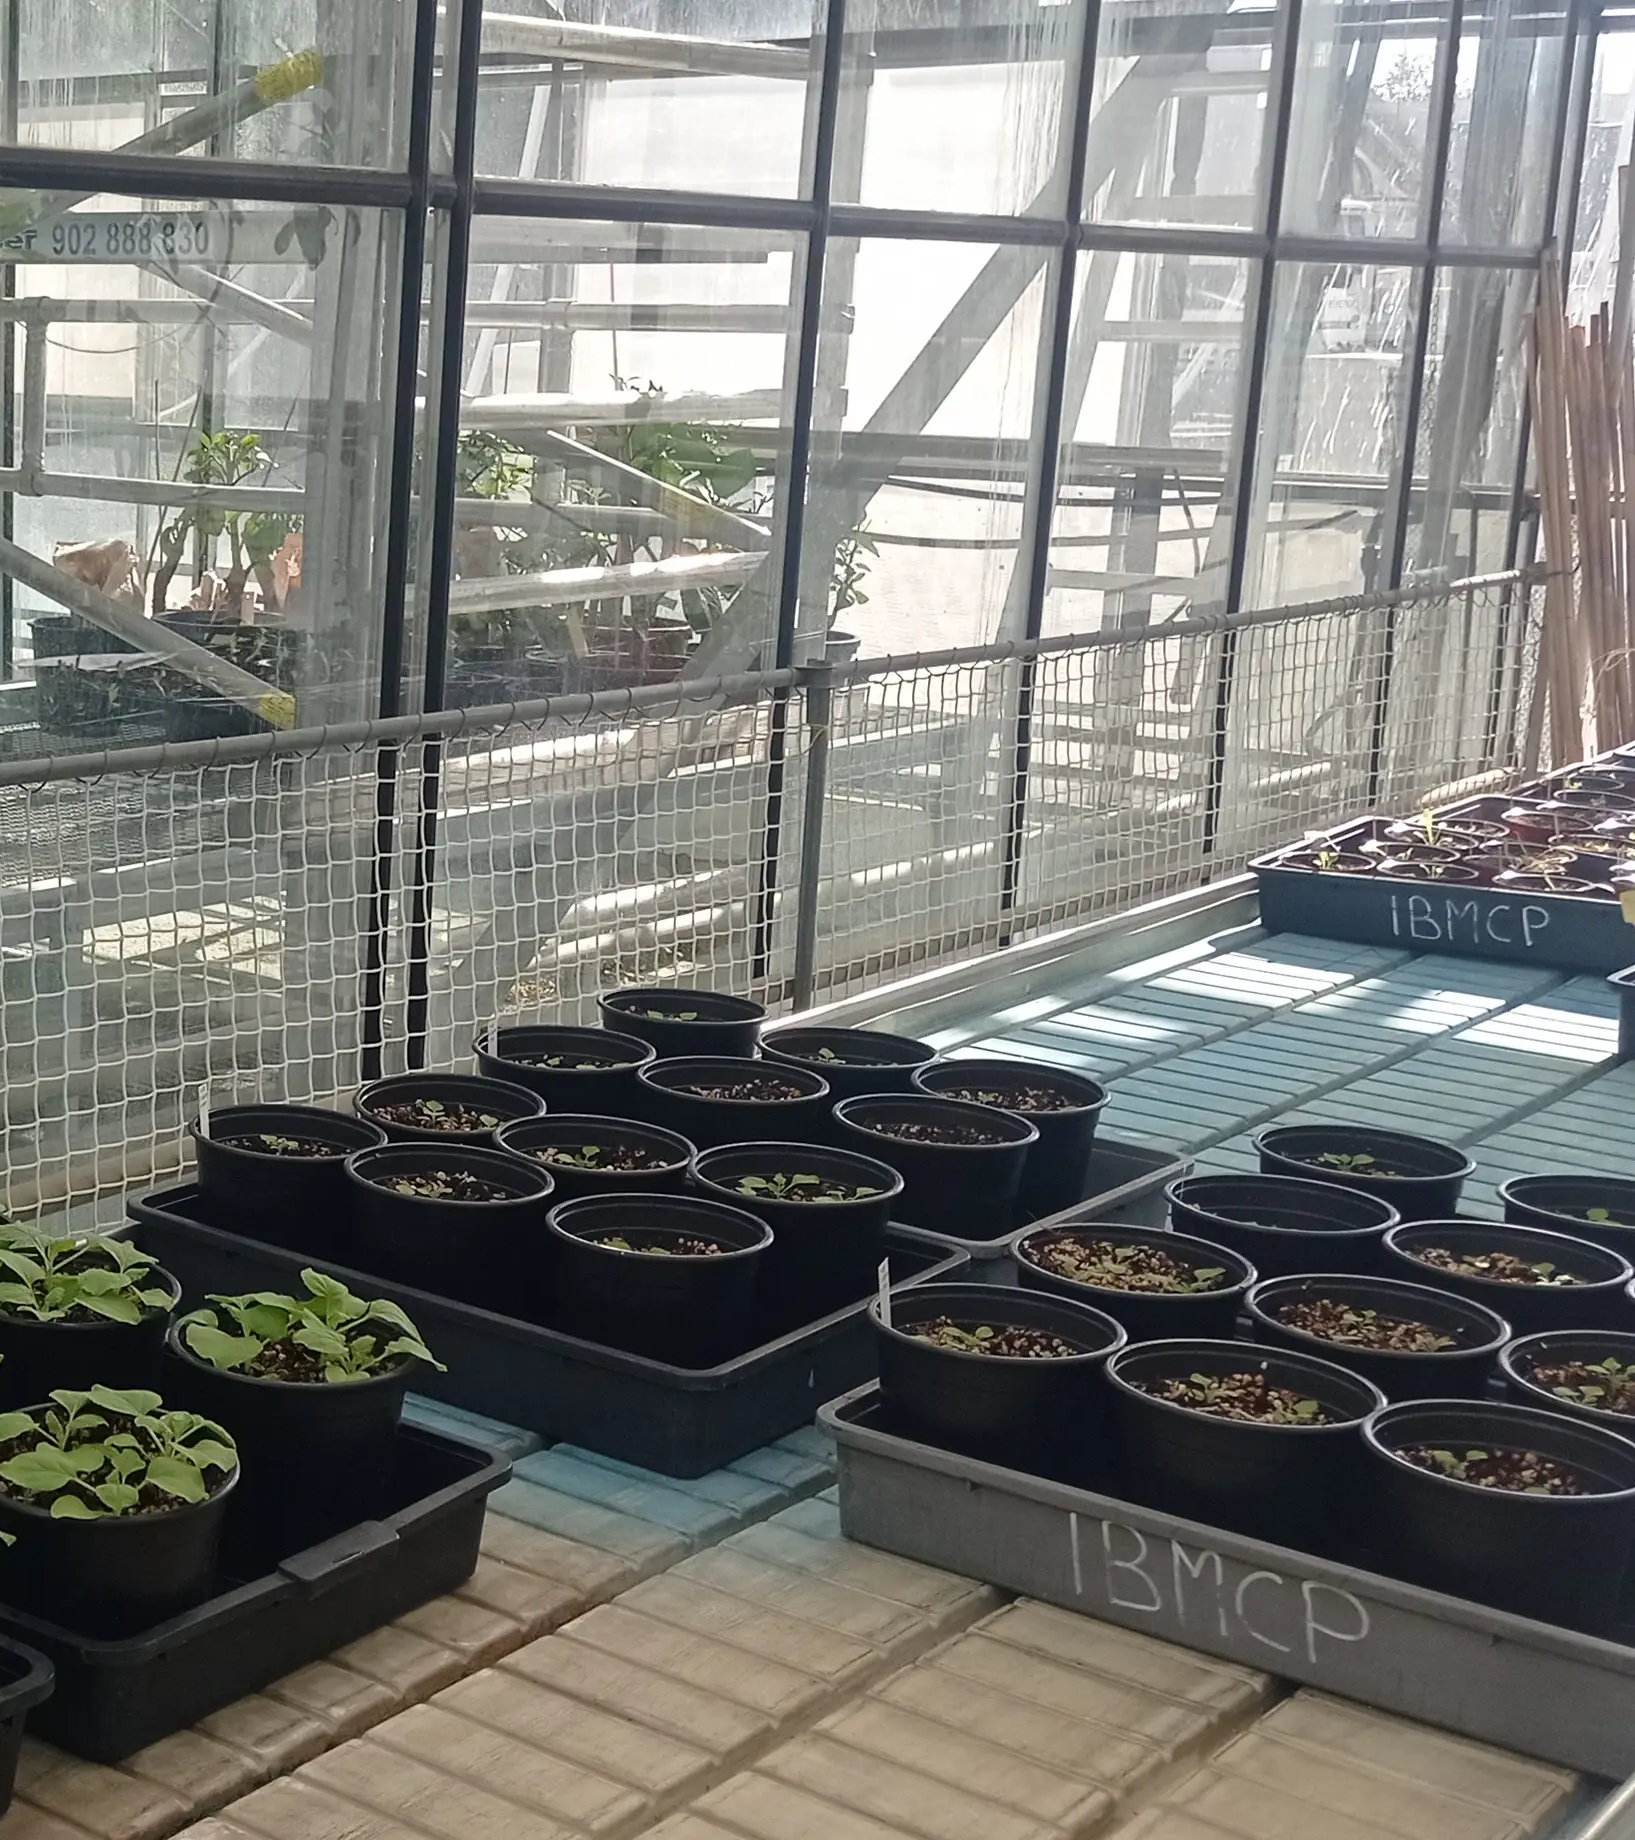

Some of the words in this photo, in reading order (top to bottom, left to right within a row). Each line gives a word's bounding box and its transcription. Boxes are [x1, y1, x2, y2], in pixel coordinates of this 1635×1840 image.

[52, 221, 97, 255] 902
[106, 221, 151, 255] 888
[162, 221, 209, 255] 830
[1391, 895, 1550, 946] IBMCP
[1070, 1512, 1370, 1663] IBMCP
